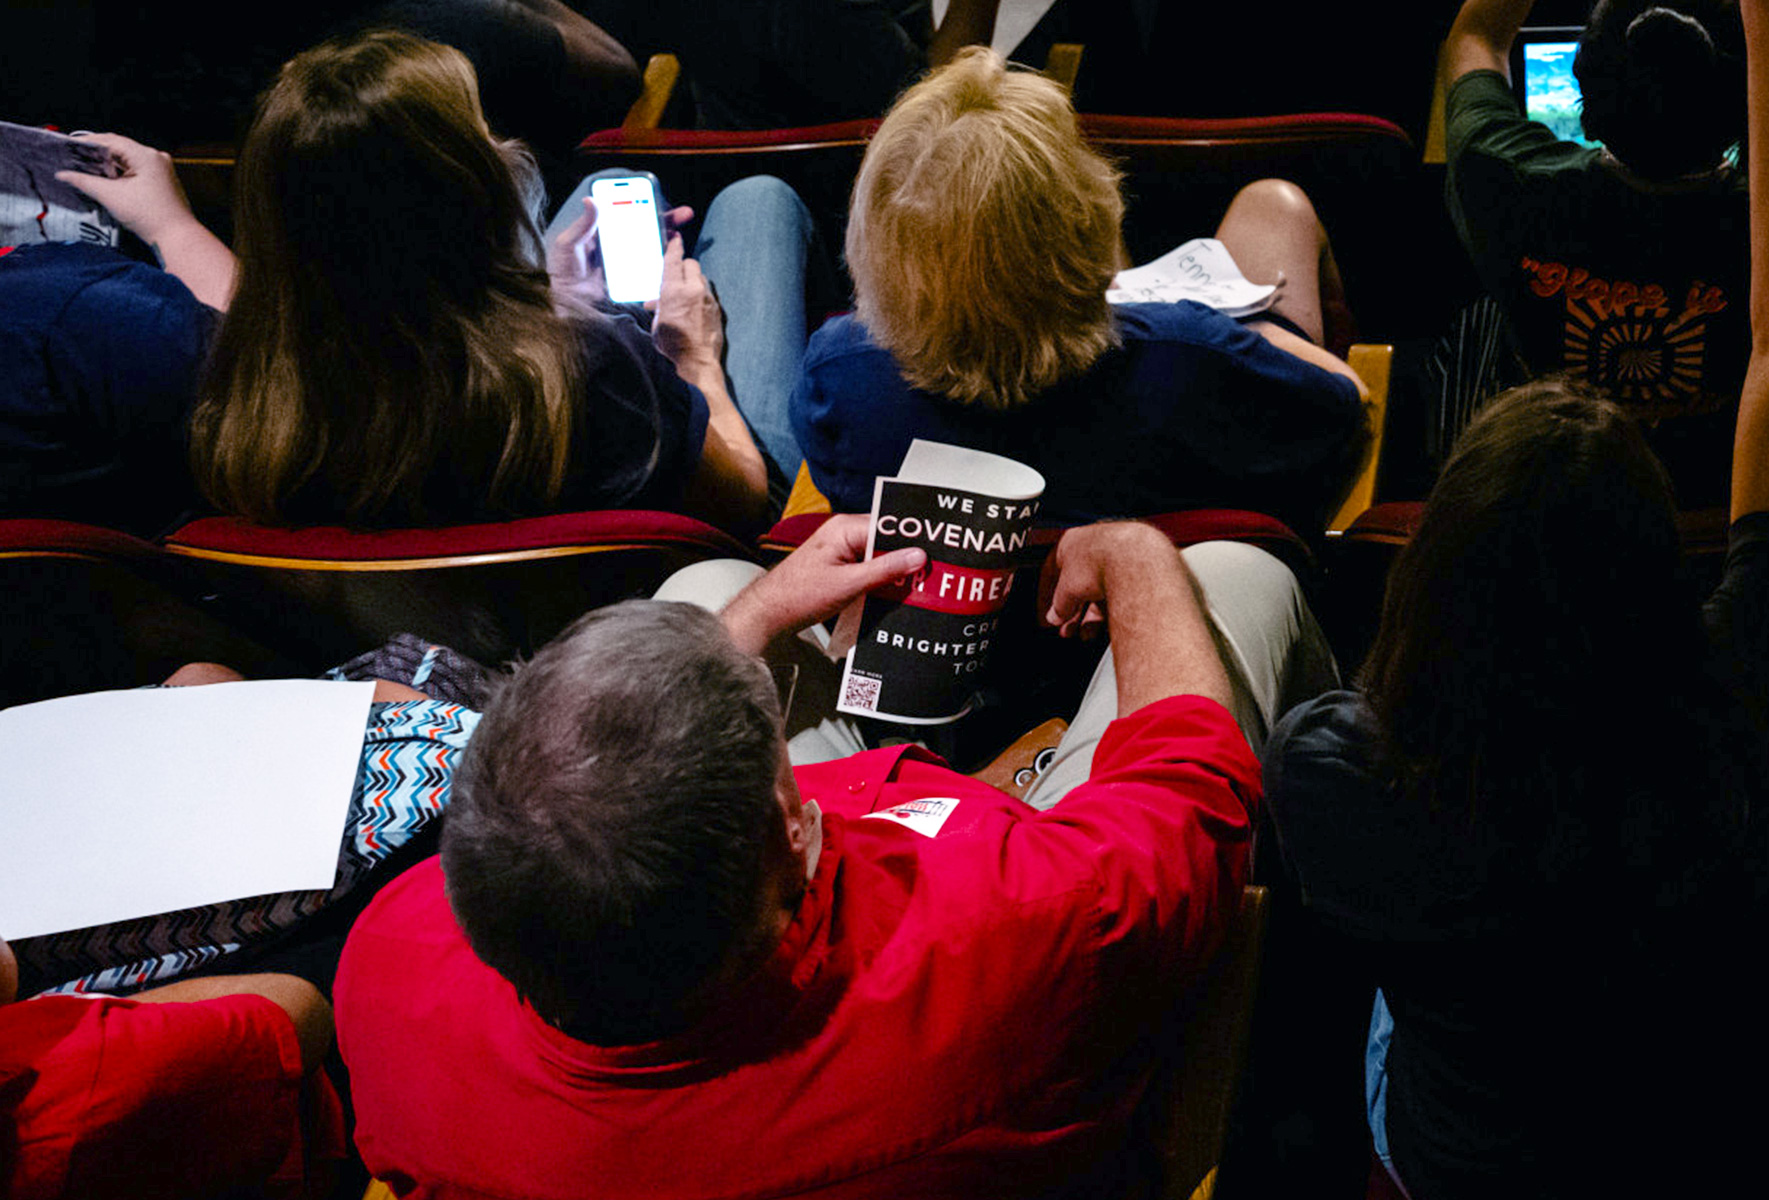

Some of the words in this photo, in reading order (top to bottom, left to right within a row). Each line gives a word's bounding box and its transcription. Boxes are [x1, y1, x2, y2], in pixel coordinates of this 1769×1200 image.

[937, 494, 974, 514] WE
[876, 514, 1031, 553] COVENAN
[876, 629, 989, 657] BRIGHTER
